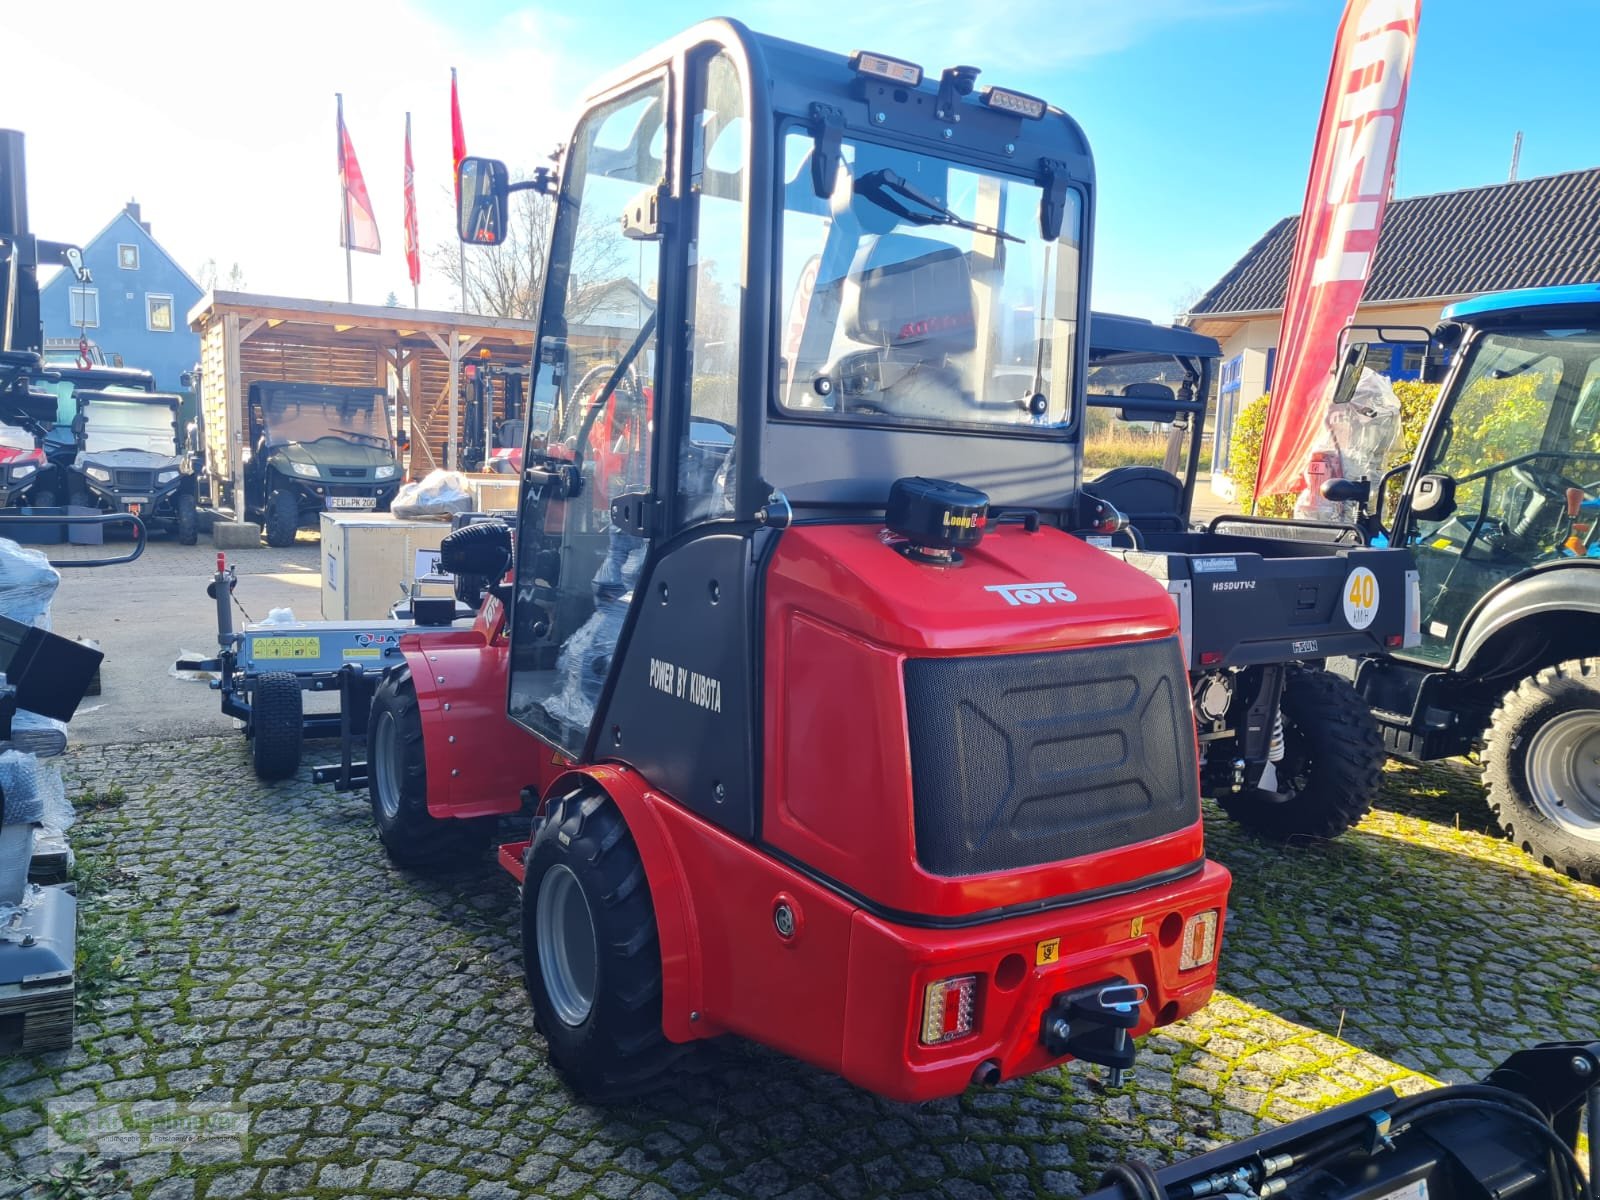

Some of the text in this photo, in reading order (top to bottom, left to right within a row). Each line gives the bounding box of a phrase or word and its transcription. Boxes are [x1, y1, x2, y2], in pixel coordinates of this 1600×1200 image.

[983, 582, 1078, 606] TOYO
[1349, 575, 1374, 608] 40
[649, 657, 721, 714] POWER BY KUBOTA
